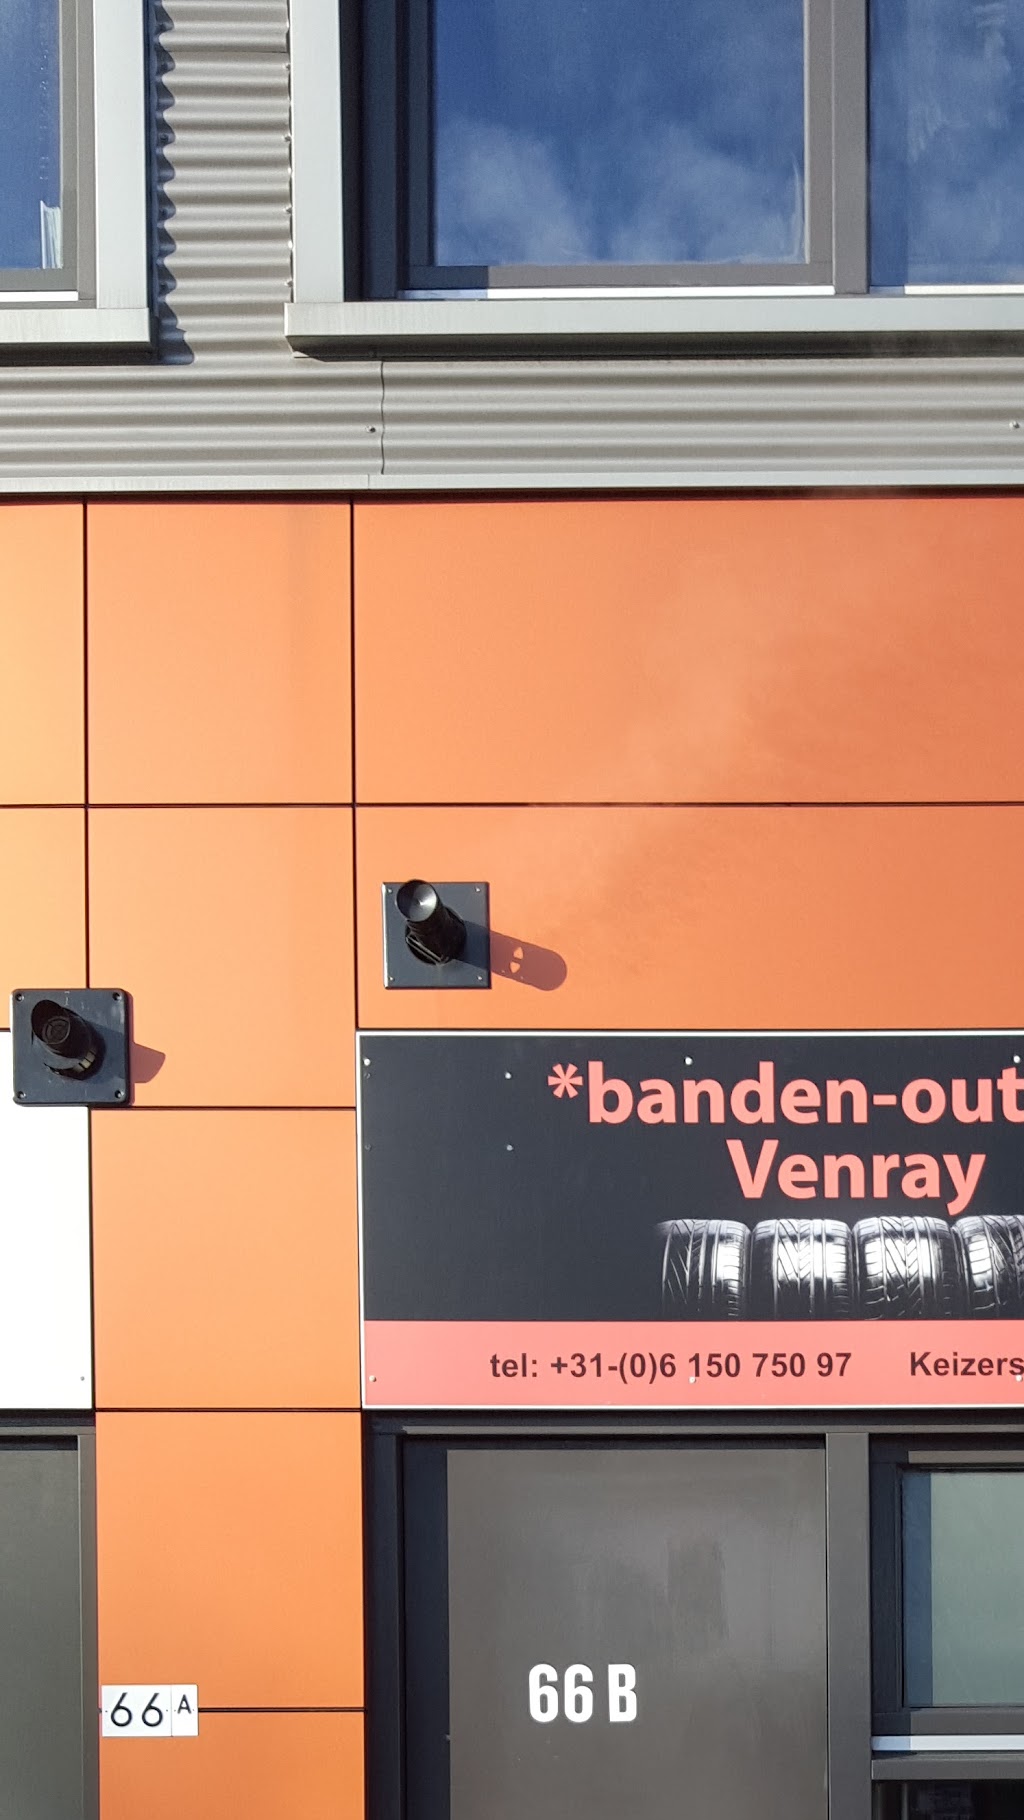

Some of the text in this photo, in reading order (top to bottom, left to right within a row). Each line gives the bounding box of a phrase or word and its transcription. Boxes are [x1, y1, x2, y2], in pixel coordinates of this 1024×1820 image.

[726, 1139, 987, 1216] Venray
[489, 1352, 852, 1385] tel: +31-(0)6 150 750 97
[110, 1692, 163, 1728] 66
